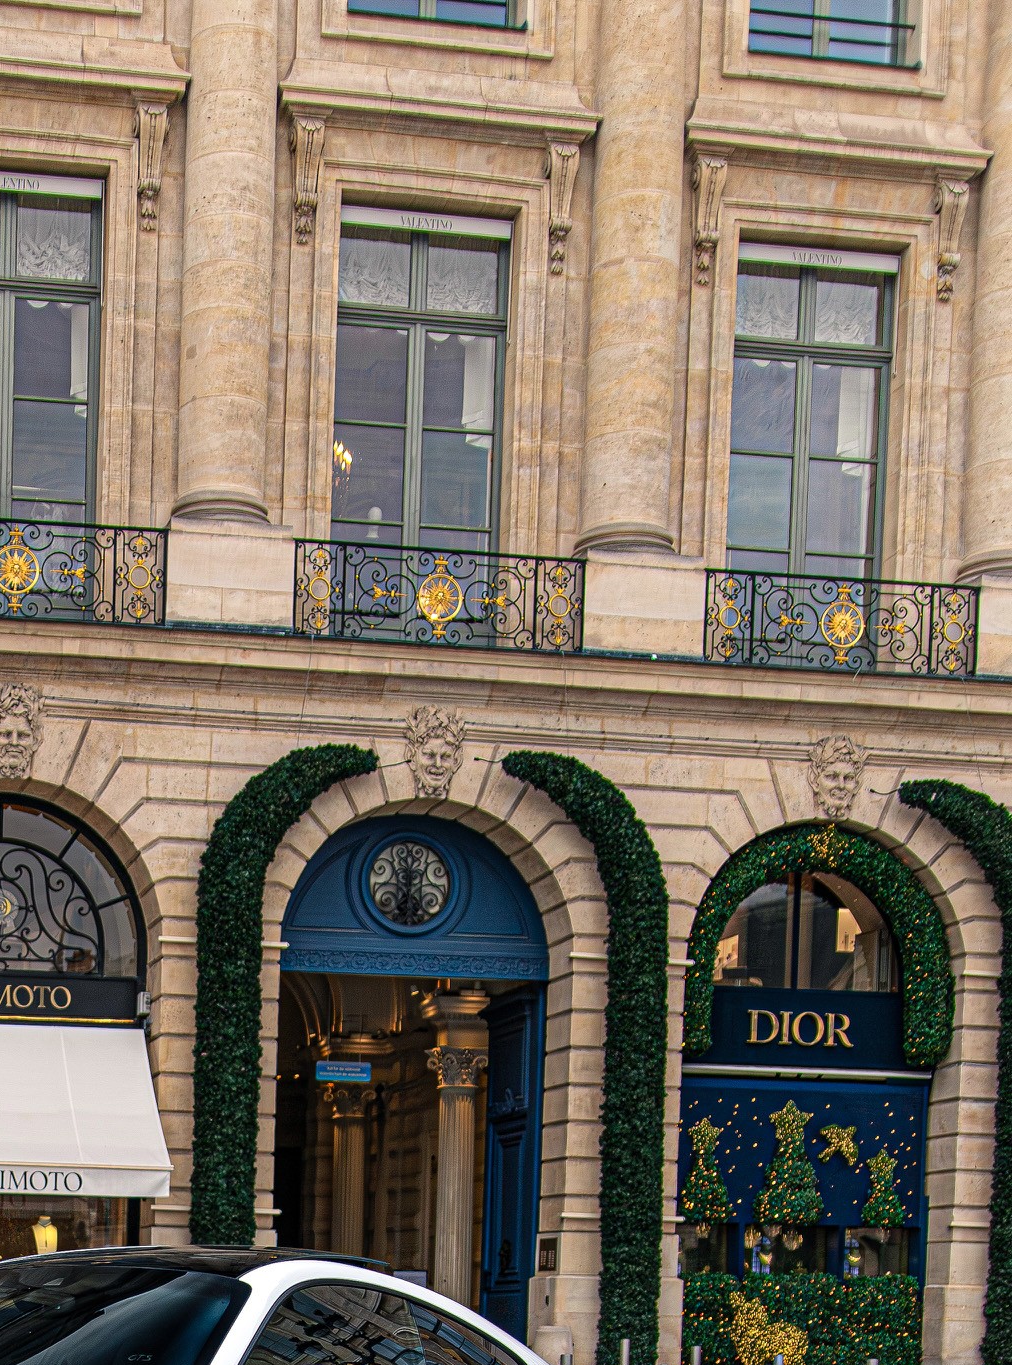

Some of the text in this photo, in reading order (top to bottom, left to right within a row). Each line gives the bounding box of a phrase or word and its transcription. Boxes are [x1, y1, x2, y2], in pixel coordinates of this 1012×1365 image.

[400, 215, 453, 231] VALENTINO
[792, 251, 843, 266] VALENTINO
[746, 1009, 855, 1048] DIOR
